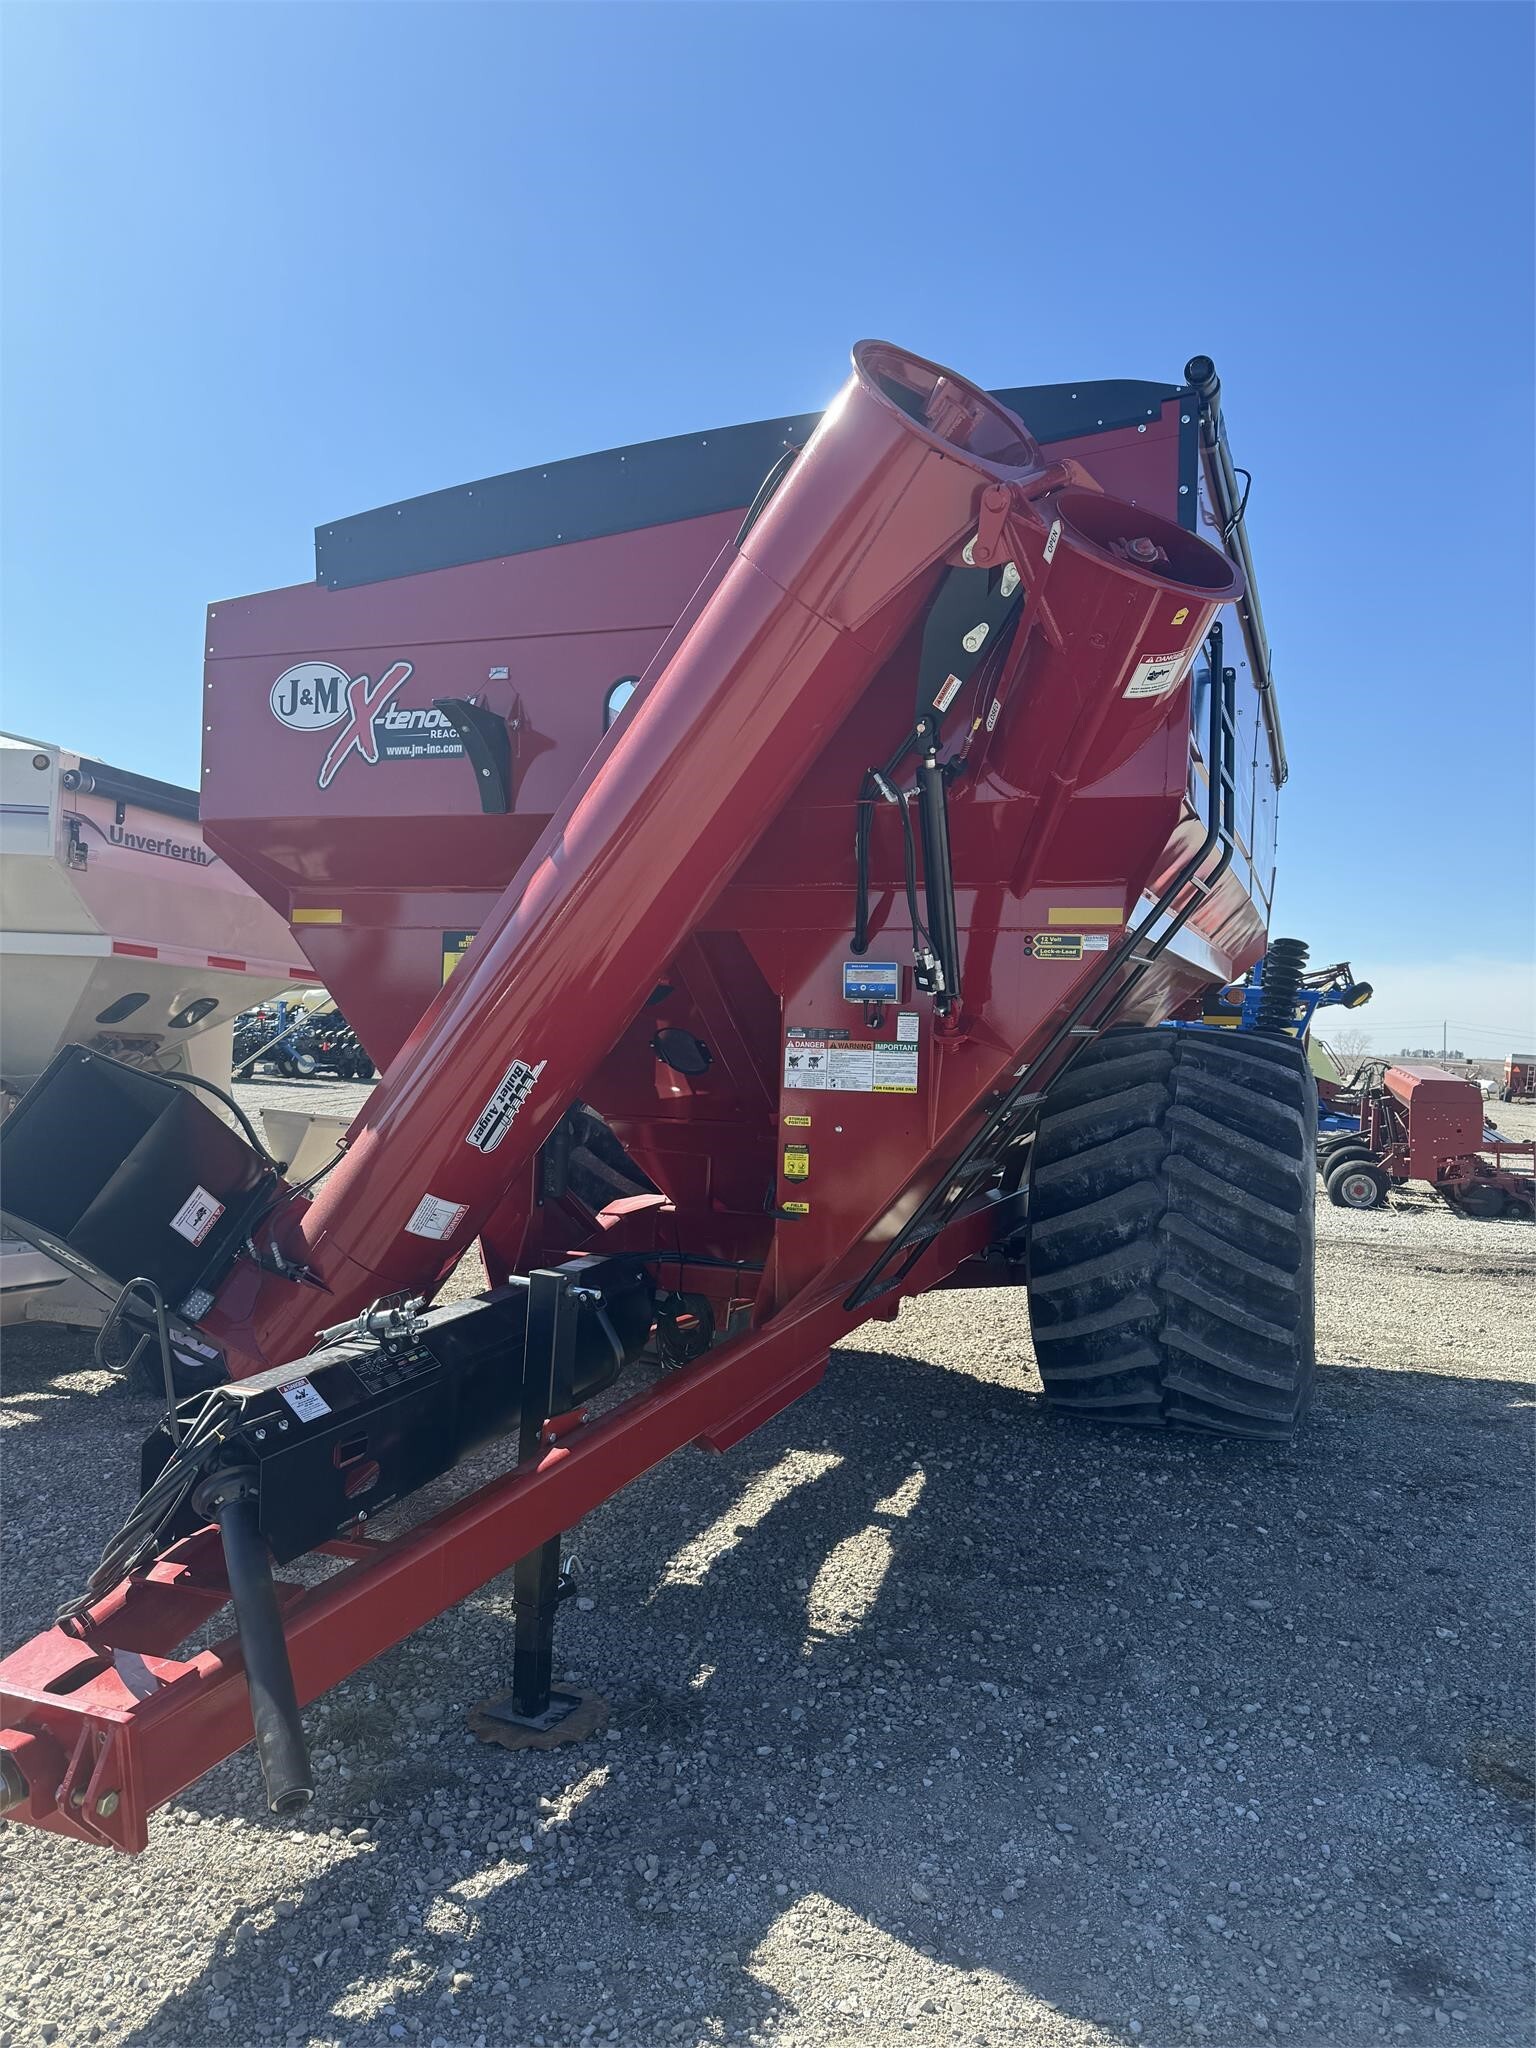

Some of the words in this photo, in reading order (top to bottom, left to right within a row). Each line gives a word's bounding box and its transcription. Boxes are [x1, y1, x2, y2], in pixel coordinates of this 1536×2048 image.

[1047, 529, 1058, 553] OPEN
[278, 676, 340, 717] J&M
[987, 702, 999, 729] CLOSED
[430, 729, 461, 739] REAC
[386, 743, 463, 757] www.jm-inc.com
[110, 824, 207, 864] Unverferth
[837, 1042, 872, 1050] WARNING
[875, 1043, 918, 1051] IMPORTANT
[497, 1065, 524, 1103] Bullet
[473, 1103, 499, 1142] Auger
[442, 1212, 463, 1239] DANGER
